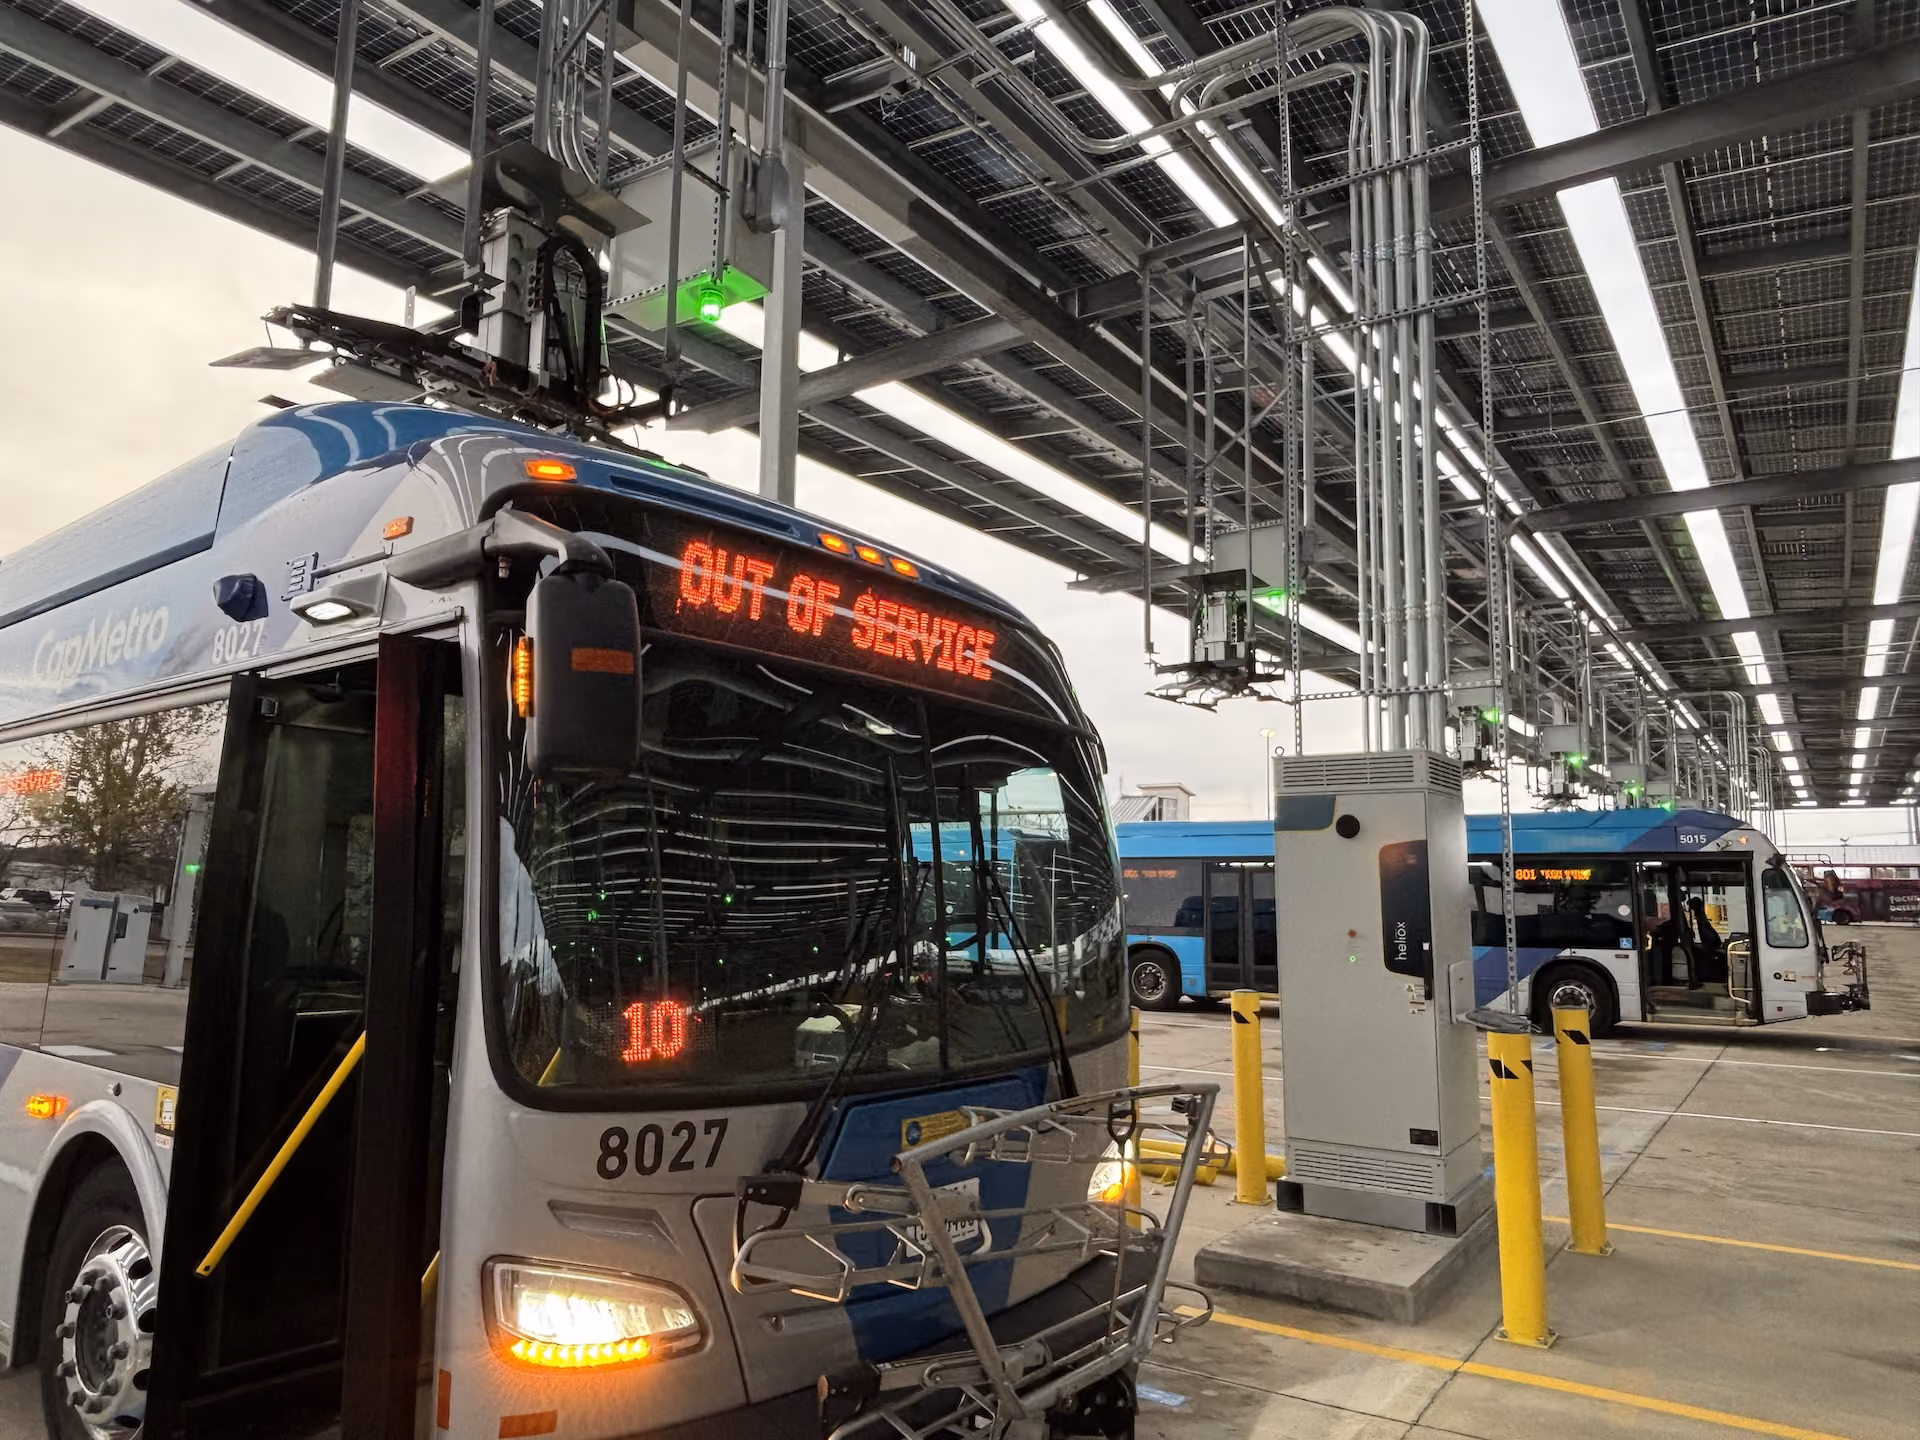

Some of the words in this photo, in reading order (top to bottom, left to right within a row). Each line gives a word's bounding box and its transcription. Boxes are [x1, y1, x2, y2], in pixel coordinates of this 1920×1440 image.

[680, 541, 774, 622] OUT
[787, 573, 841, 637] OF
[851, 591, 996, 682] SERVICE
[34, 606, 169, 686] CapMetro
[213, 622, 264, 665] 8027
[1680, 834, 1707, 844] 5015
[1515, 868, 1537, 880] 801
[1394, 921, 1408, 960] heliox
[621, 1000, 687, 1063] 10
[596, 1118, 729, 1180] 8027
